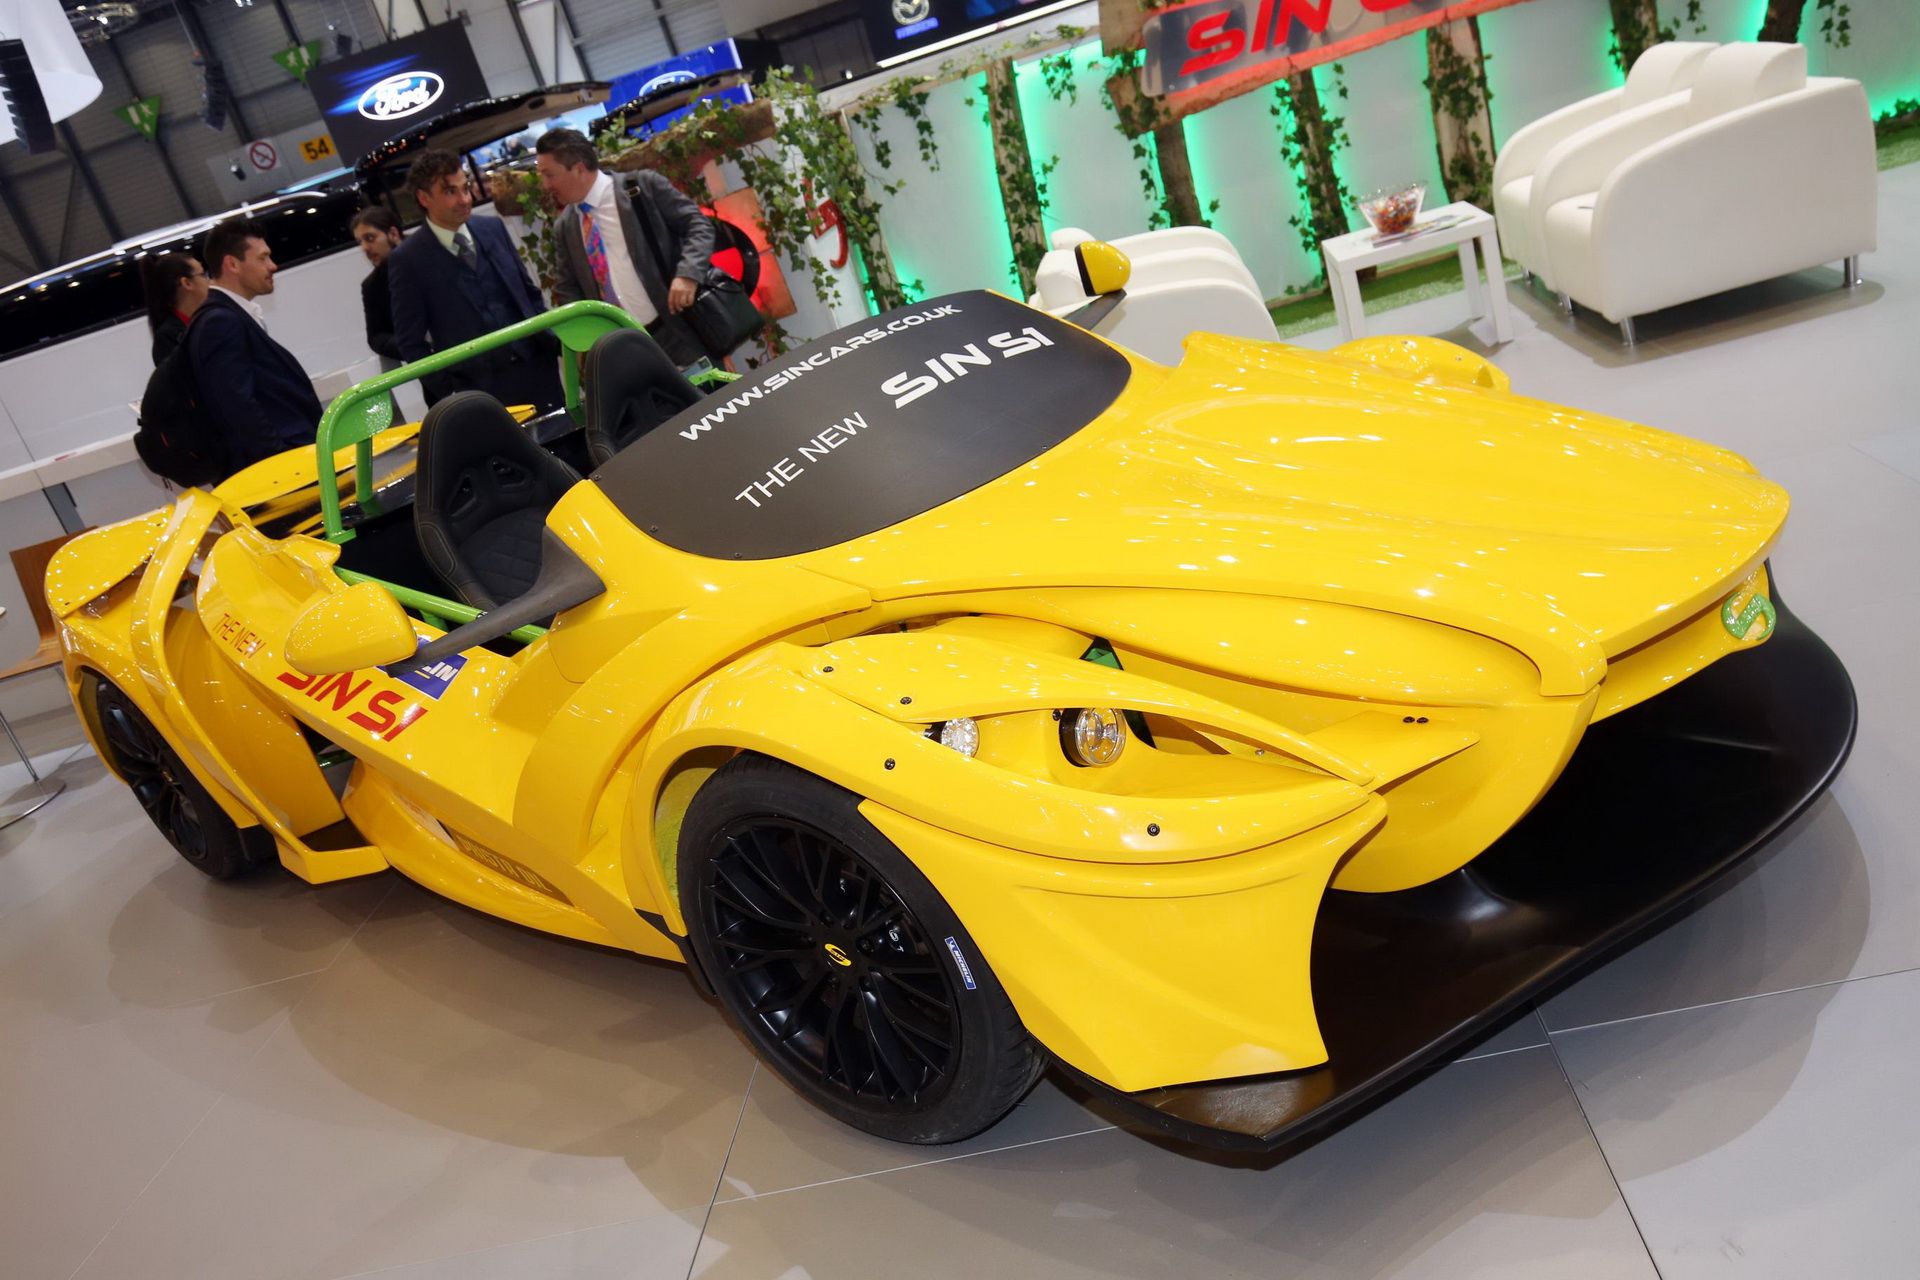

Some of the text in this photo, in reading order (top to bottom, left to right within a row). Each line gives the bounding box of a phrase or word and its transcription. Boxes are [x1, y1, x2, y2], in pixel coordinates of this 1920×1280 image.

[1178, 0, 1331, 76] SIN
[374, 79, 430, 116] Ford
[304, 136, 330, 160] 54
[679, 304, 962, 441] WWW.SINCARS.CO.UK
[735, 327, 1054, 508] THE NEW SIN S1
[213, 613, 240, 641] THE
[230, 627, 267, 659] NEW
[953, 949, 973, 984] MICHELIN
